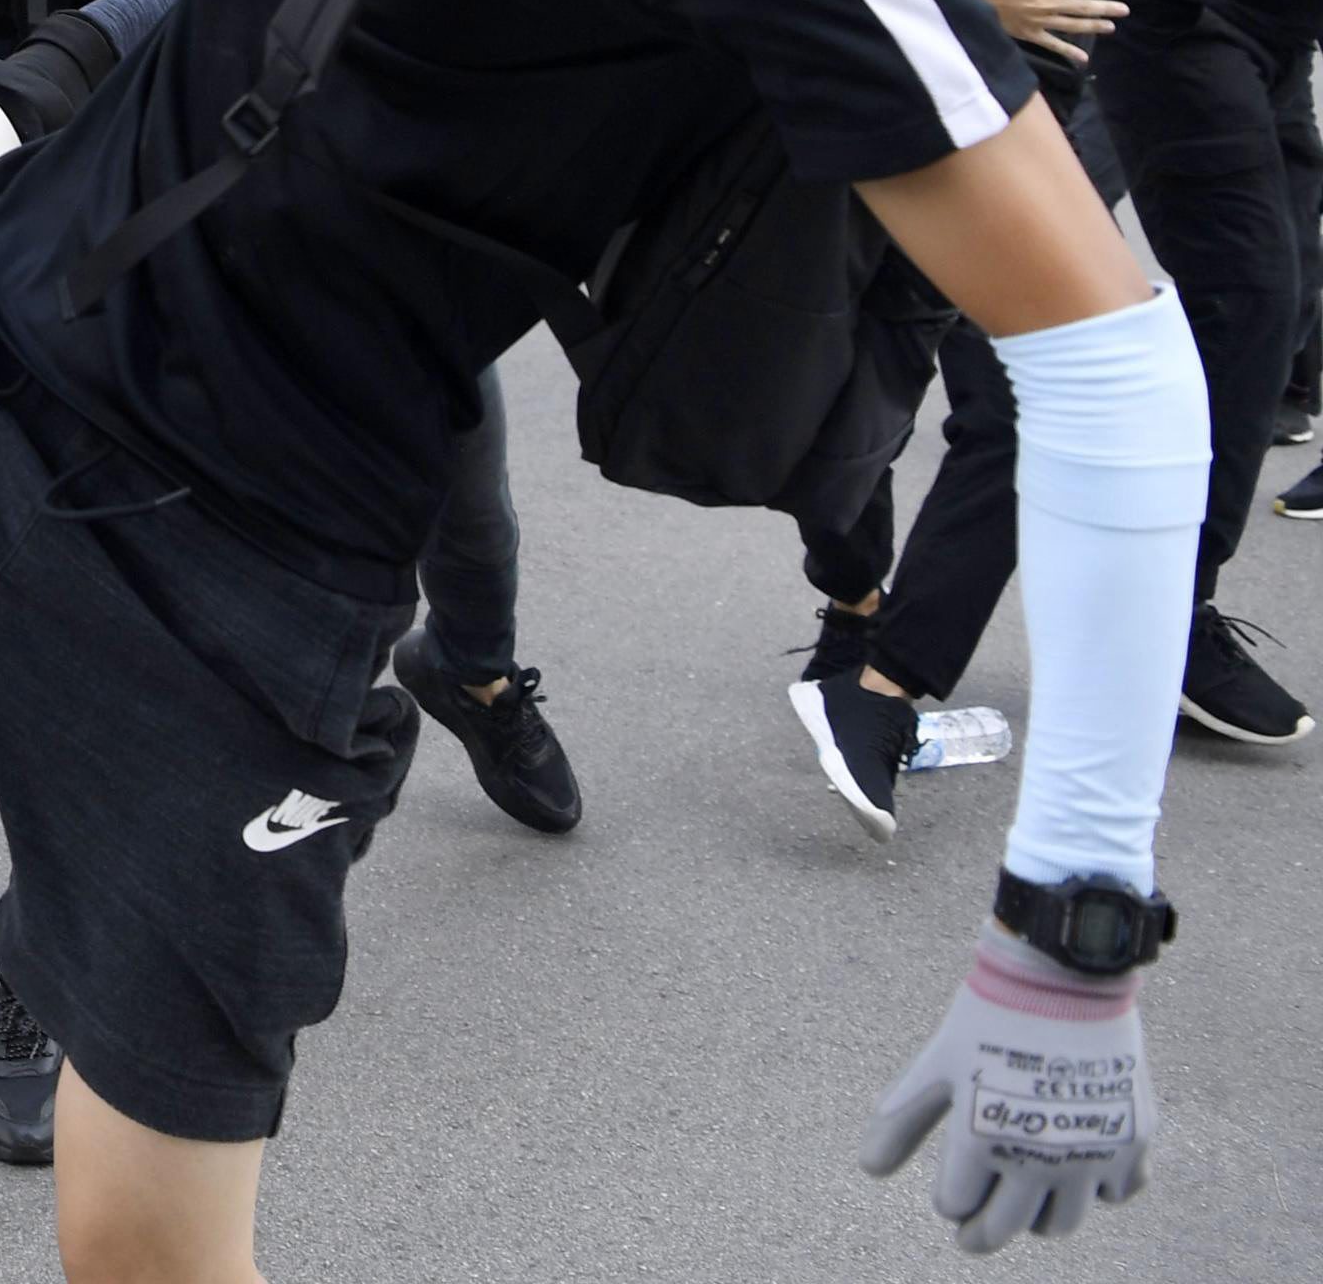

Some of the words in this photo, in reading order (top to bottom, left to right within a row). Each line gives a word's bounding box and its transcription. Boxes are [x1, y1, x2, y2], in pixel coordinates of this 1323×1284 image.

[270, 787, 342, 829] NIKE
[982, 1101, 1048, 1136] Grip
[1054, 1113, 1126, 1136] Flexo
